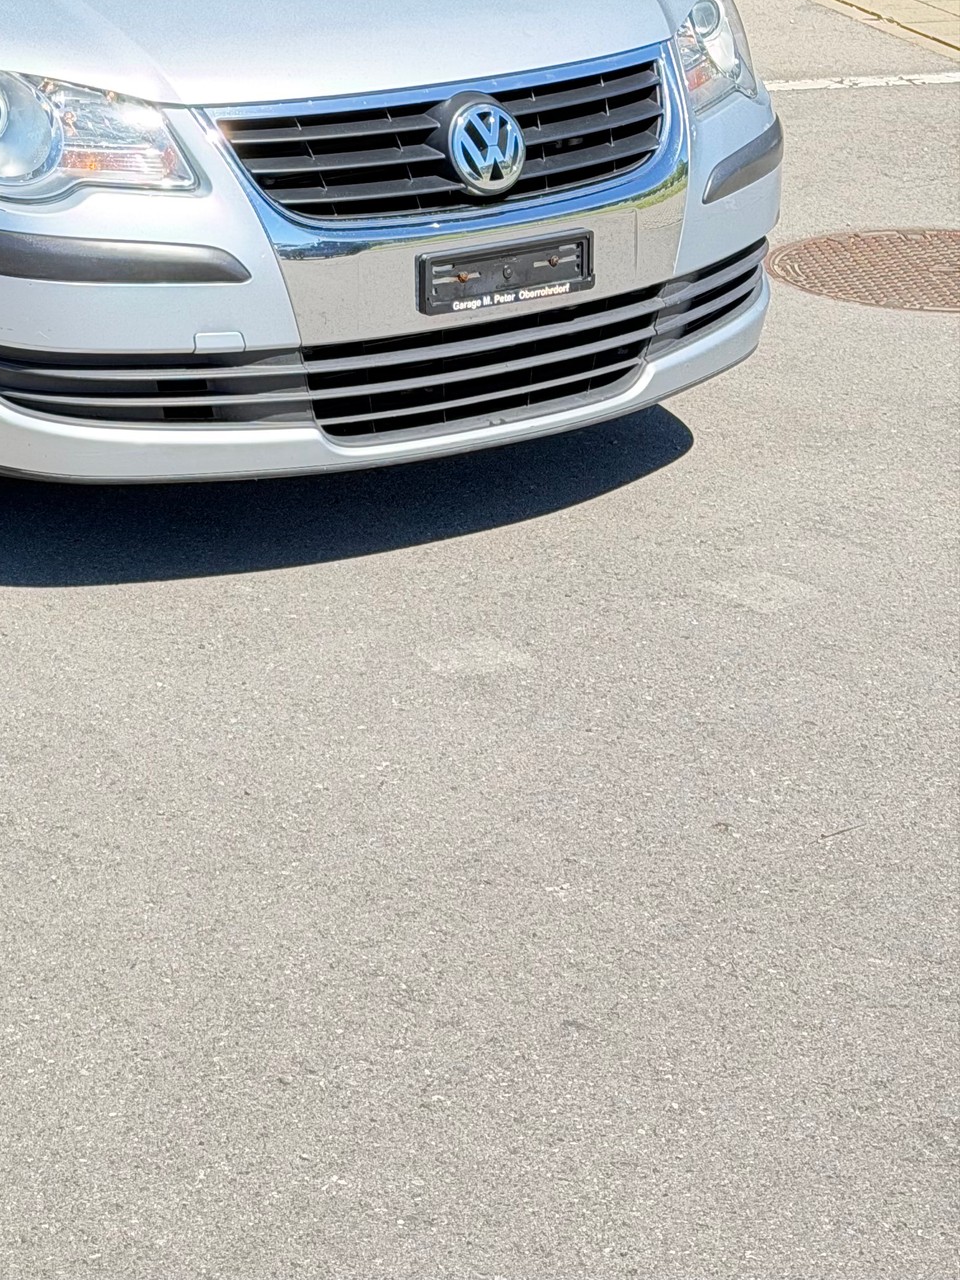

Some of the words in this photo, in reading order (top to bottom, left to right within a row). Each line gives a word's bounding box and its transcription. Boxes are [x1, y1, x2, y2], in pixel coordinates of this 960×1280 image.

[450, 104, 523, 191] VW
[452, 300, 482, 311] Garage
[483, 296, 493, 306] M.
[494, 293, 516, 304] Peter
[518, 282, 571, 300] Oberrohrdorf
